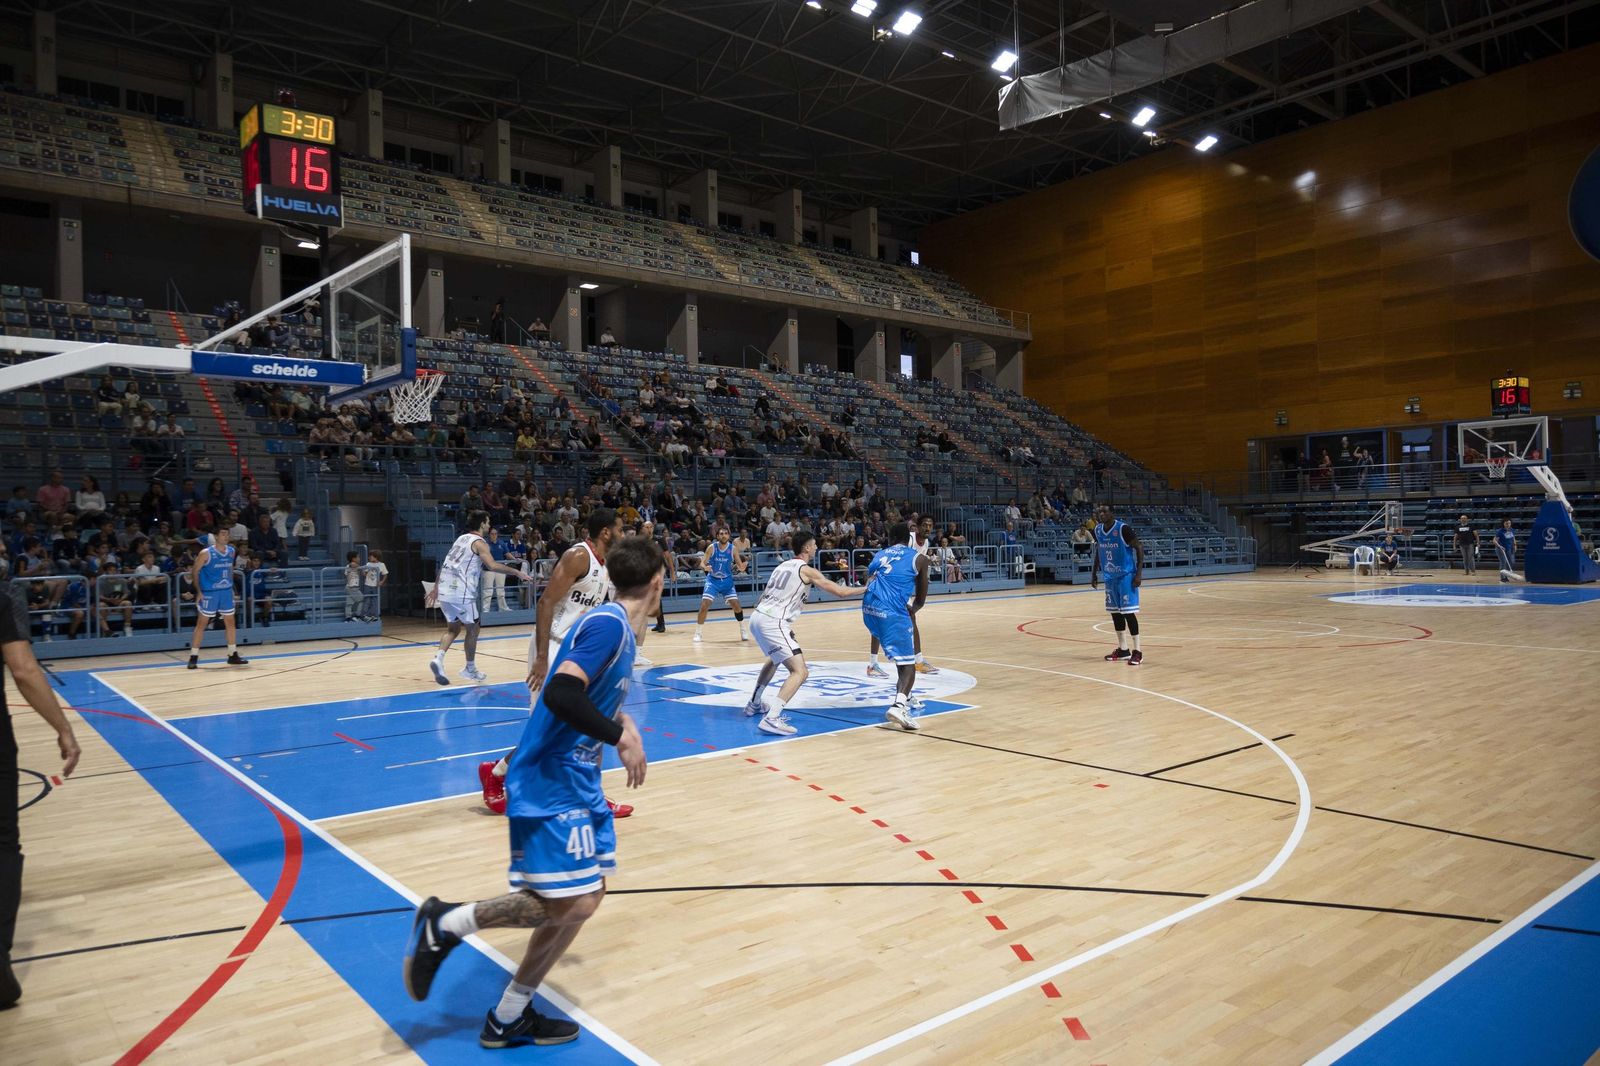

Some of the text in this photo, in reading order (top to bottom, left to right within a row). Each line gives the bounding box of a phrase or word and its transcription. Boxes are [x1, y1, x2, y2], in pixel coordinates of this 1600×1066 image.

[281, 110, 334, 141] 3:30
[291, 147, 328, 191] 16
[263, 195, 339, 217] HUELVA
[252, 363, 318, 378] schelde
[1498, 377, 1517, 388] 3:30
[1501, 389, 1516, 404] 16
[767, 570, 793, 591] 30
[566, 823, 596, 861] 40
